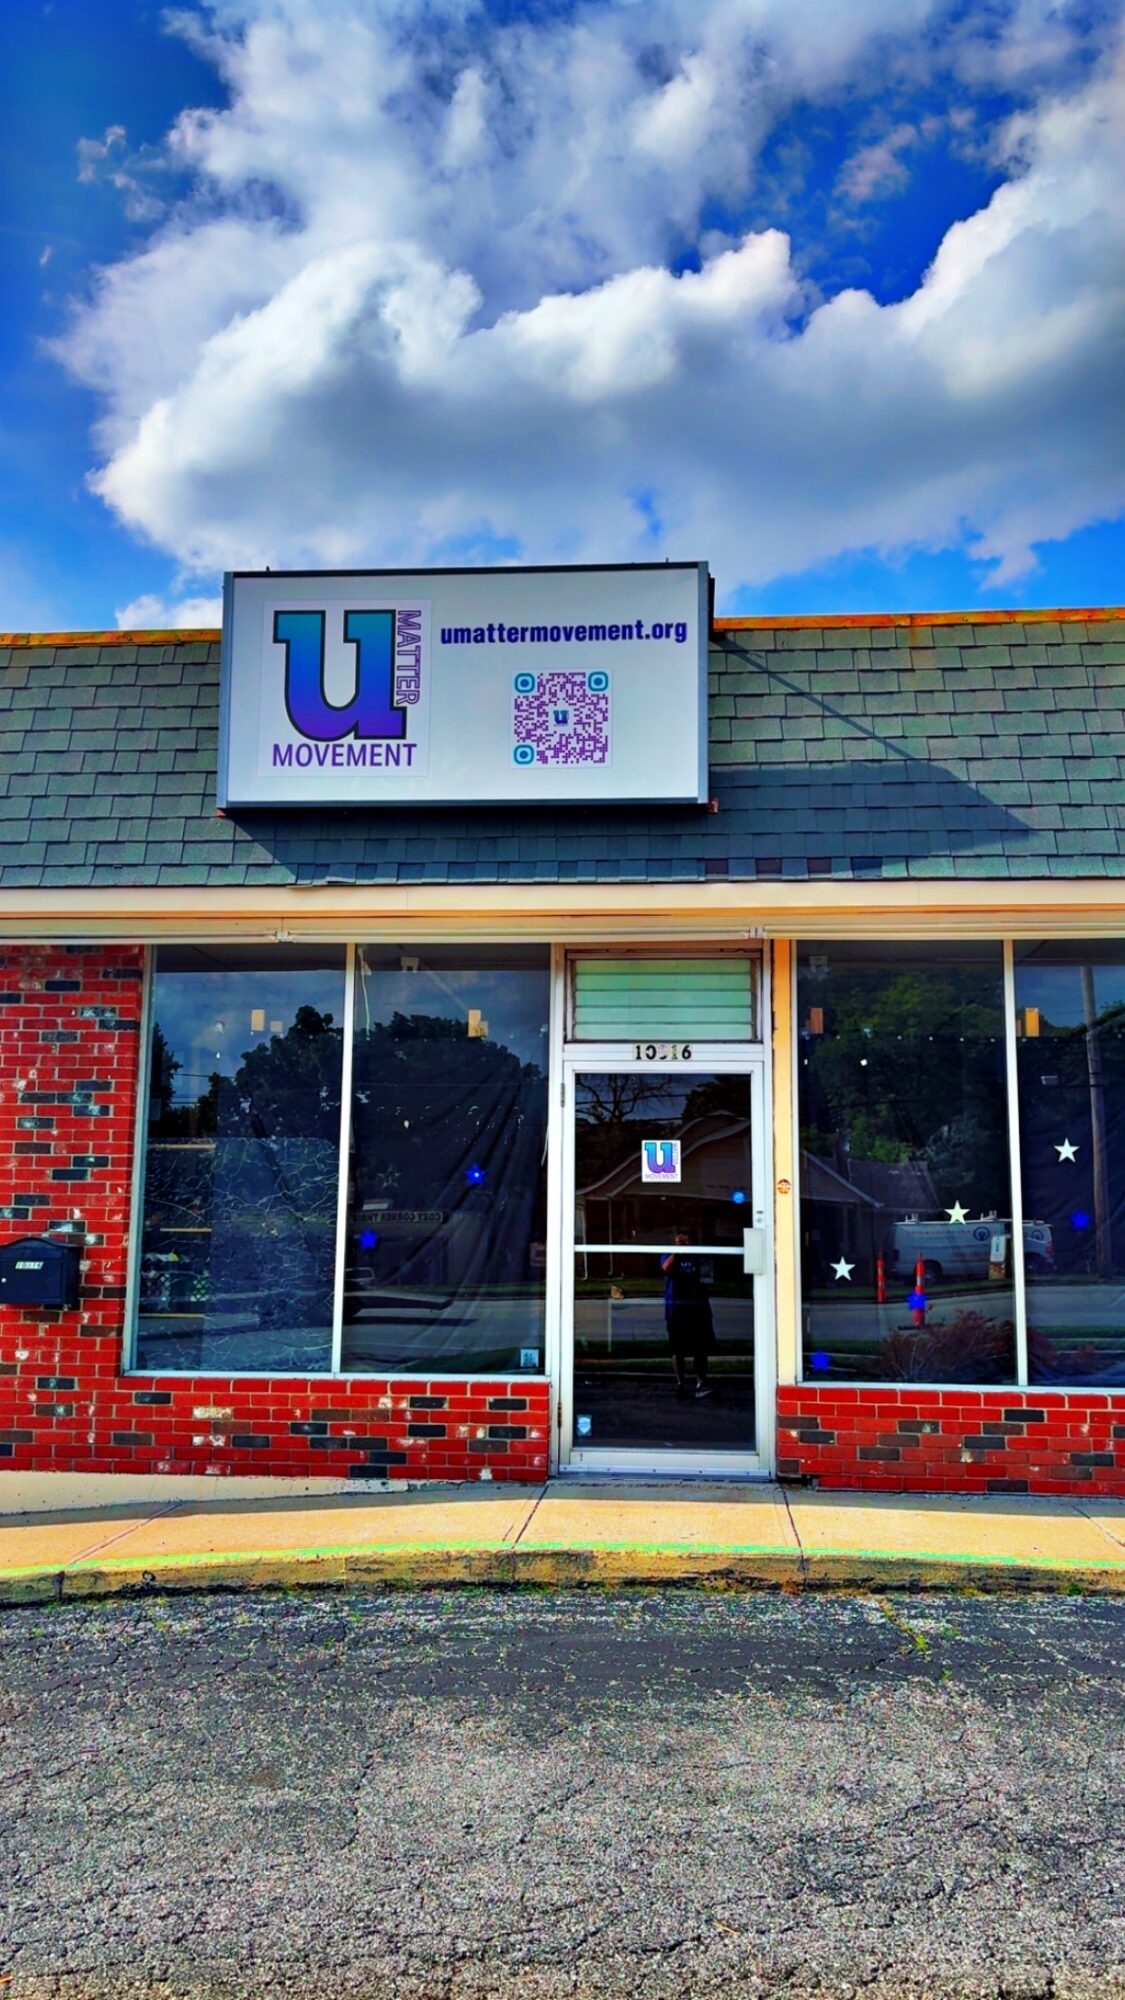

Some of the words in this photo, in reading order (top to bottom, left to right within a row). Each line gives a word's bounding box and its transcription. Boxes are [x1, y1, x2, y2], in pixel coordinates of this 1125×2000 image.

[440, 620, 687, 644] umattermovement.org
[397, 610, 421, 706] MATTER
[272, 744, 417, 767] MOVEMENT
